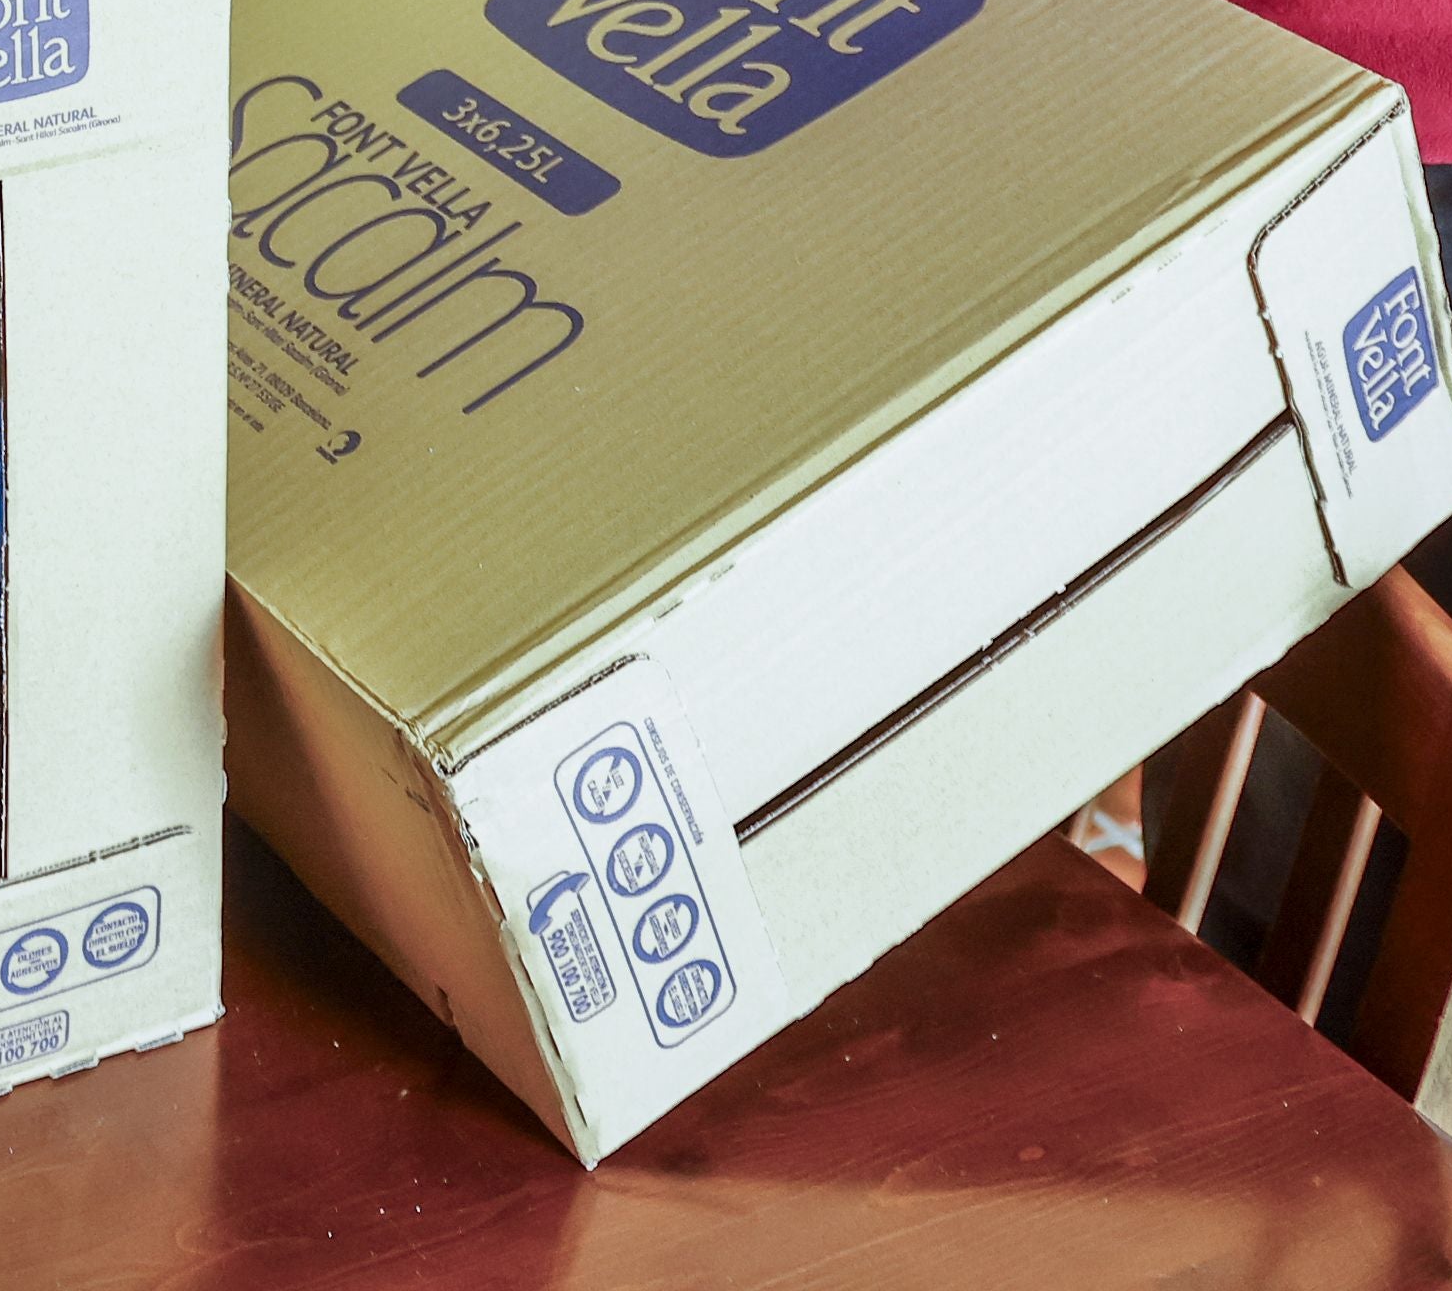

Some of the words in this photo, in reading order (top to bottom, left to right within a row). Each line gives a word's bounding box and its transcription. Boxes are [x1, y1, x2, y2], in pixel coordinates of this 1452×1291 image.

[33, 106, 96, 129] NATURAL
[443, 97, 563, 184] 3x6,25L
[310, 100, 407, 163] FONT
[393, 152, 492, 231] VELLA
[278, 310, 359, 376] NATURAL
[1351, 306, 1397, 431] Vella
[1385, 278, 1432, 397] Font
[30, 1035, 59, 1056] 700
